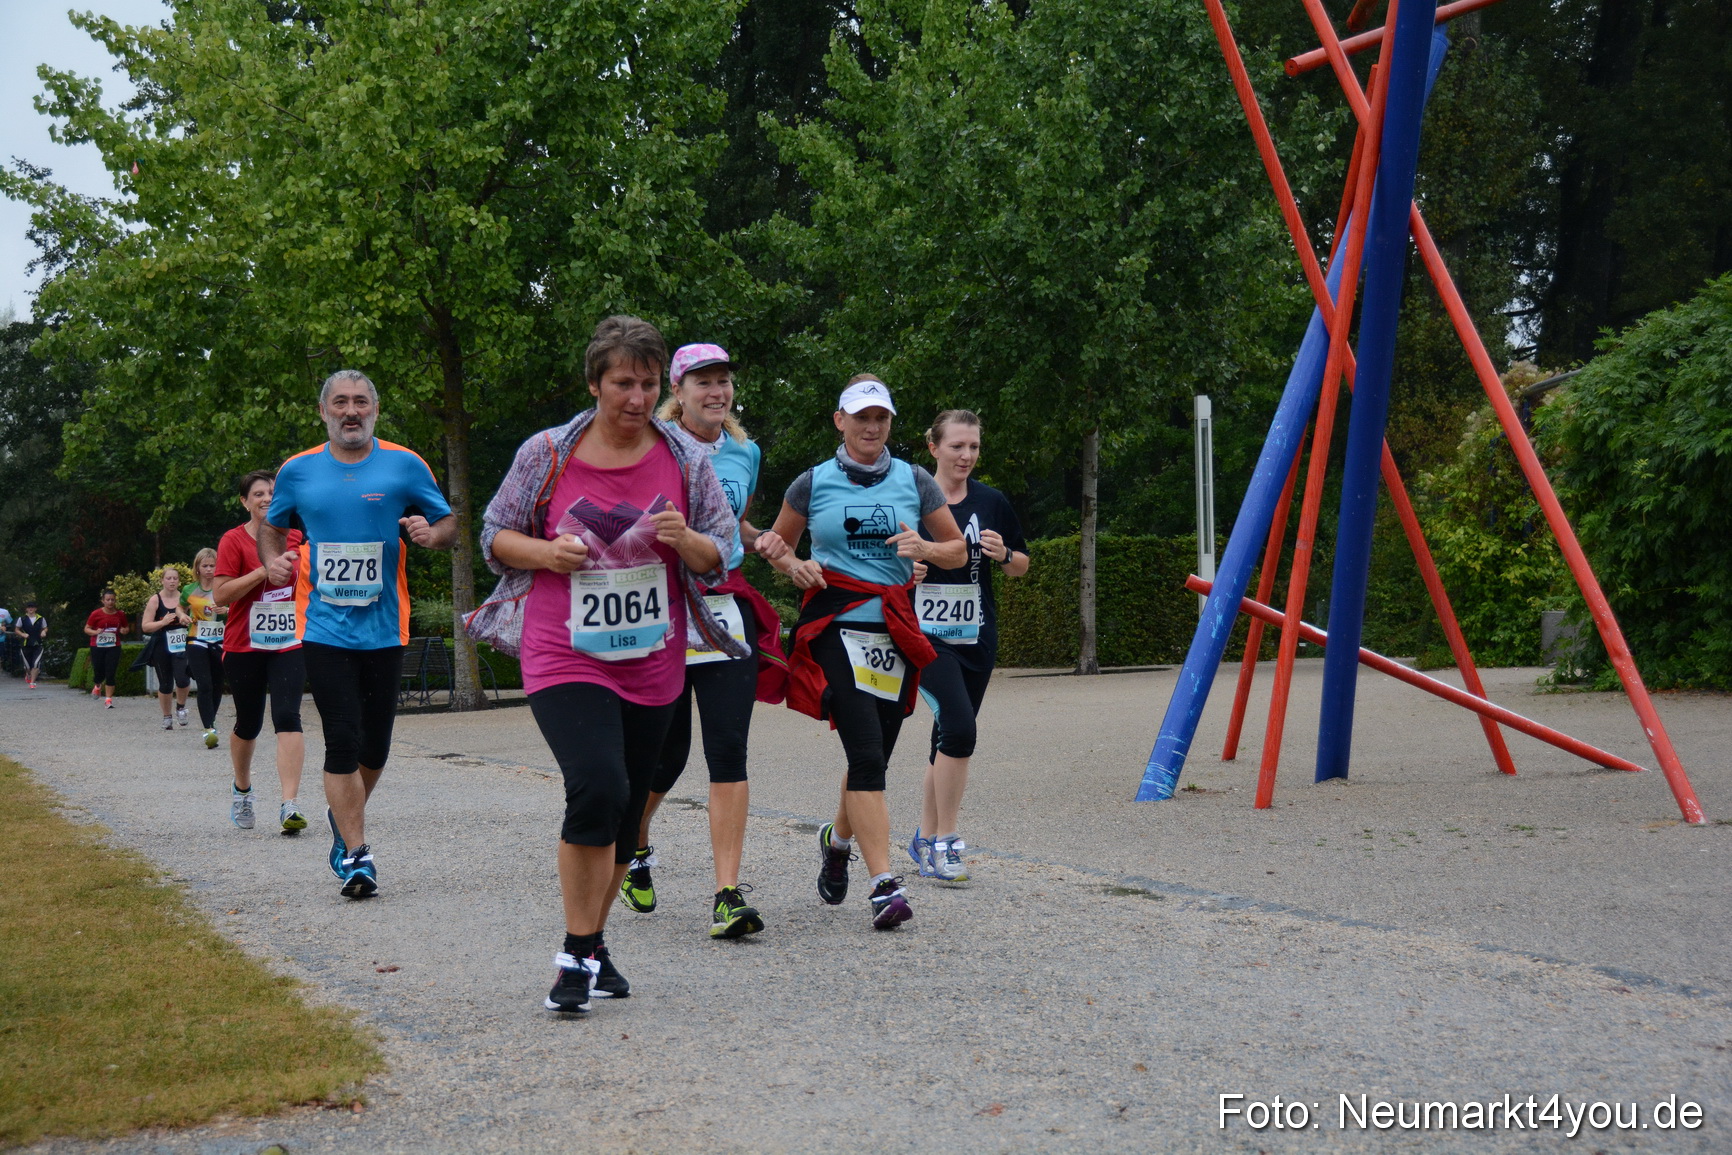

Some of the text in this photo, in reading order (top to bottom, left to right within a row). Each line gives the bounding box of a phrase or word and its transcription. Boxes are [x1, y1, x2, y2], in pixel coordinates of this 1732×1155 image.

[847, 541, 893, 550] HIRSCH
[324, 558, 377, 582] 2278
[615, 567, 657, 583] BOCK
[334, 587, 368, 598] Werner
[582, 587, 661, 627] 2064
[922, 599, 975, 622] 2240
[256, 613, 296, 632] 2595
[170, 633, 187, 644] 280
[200, 627, 224, 637] 2749
[932, 628, 963, 637] Daniela
[610, 635, 637, 648] Lisa
